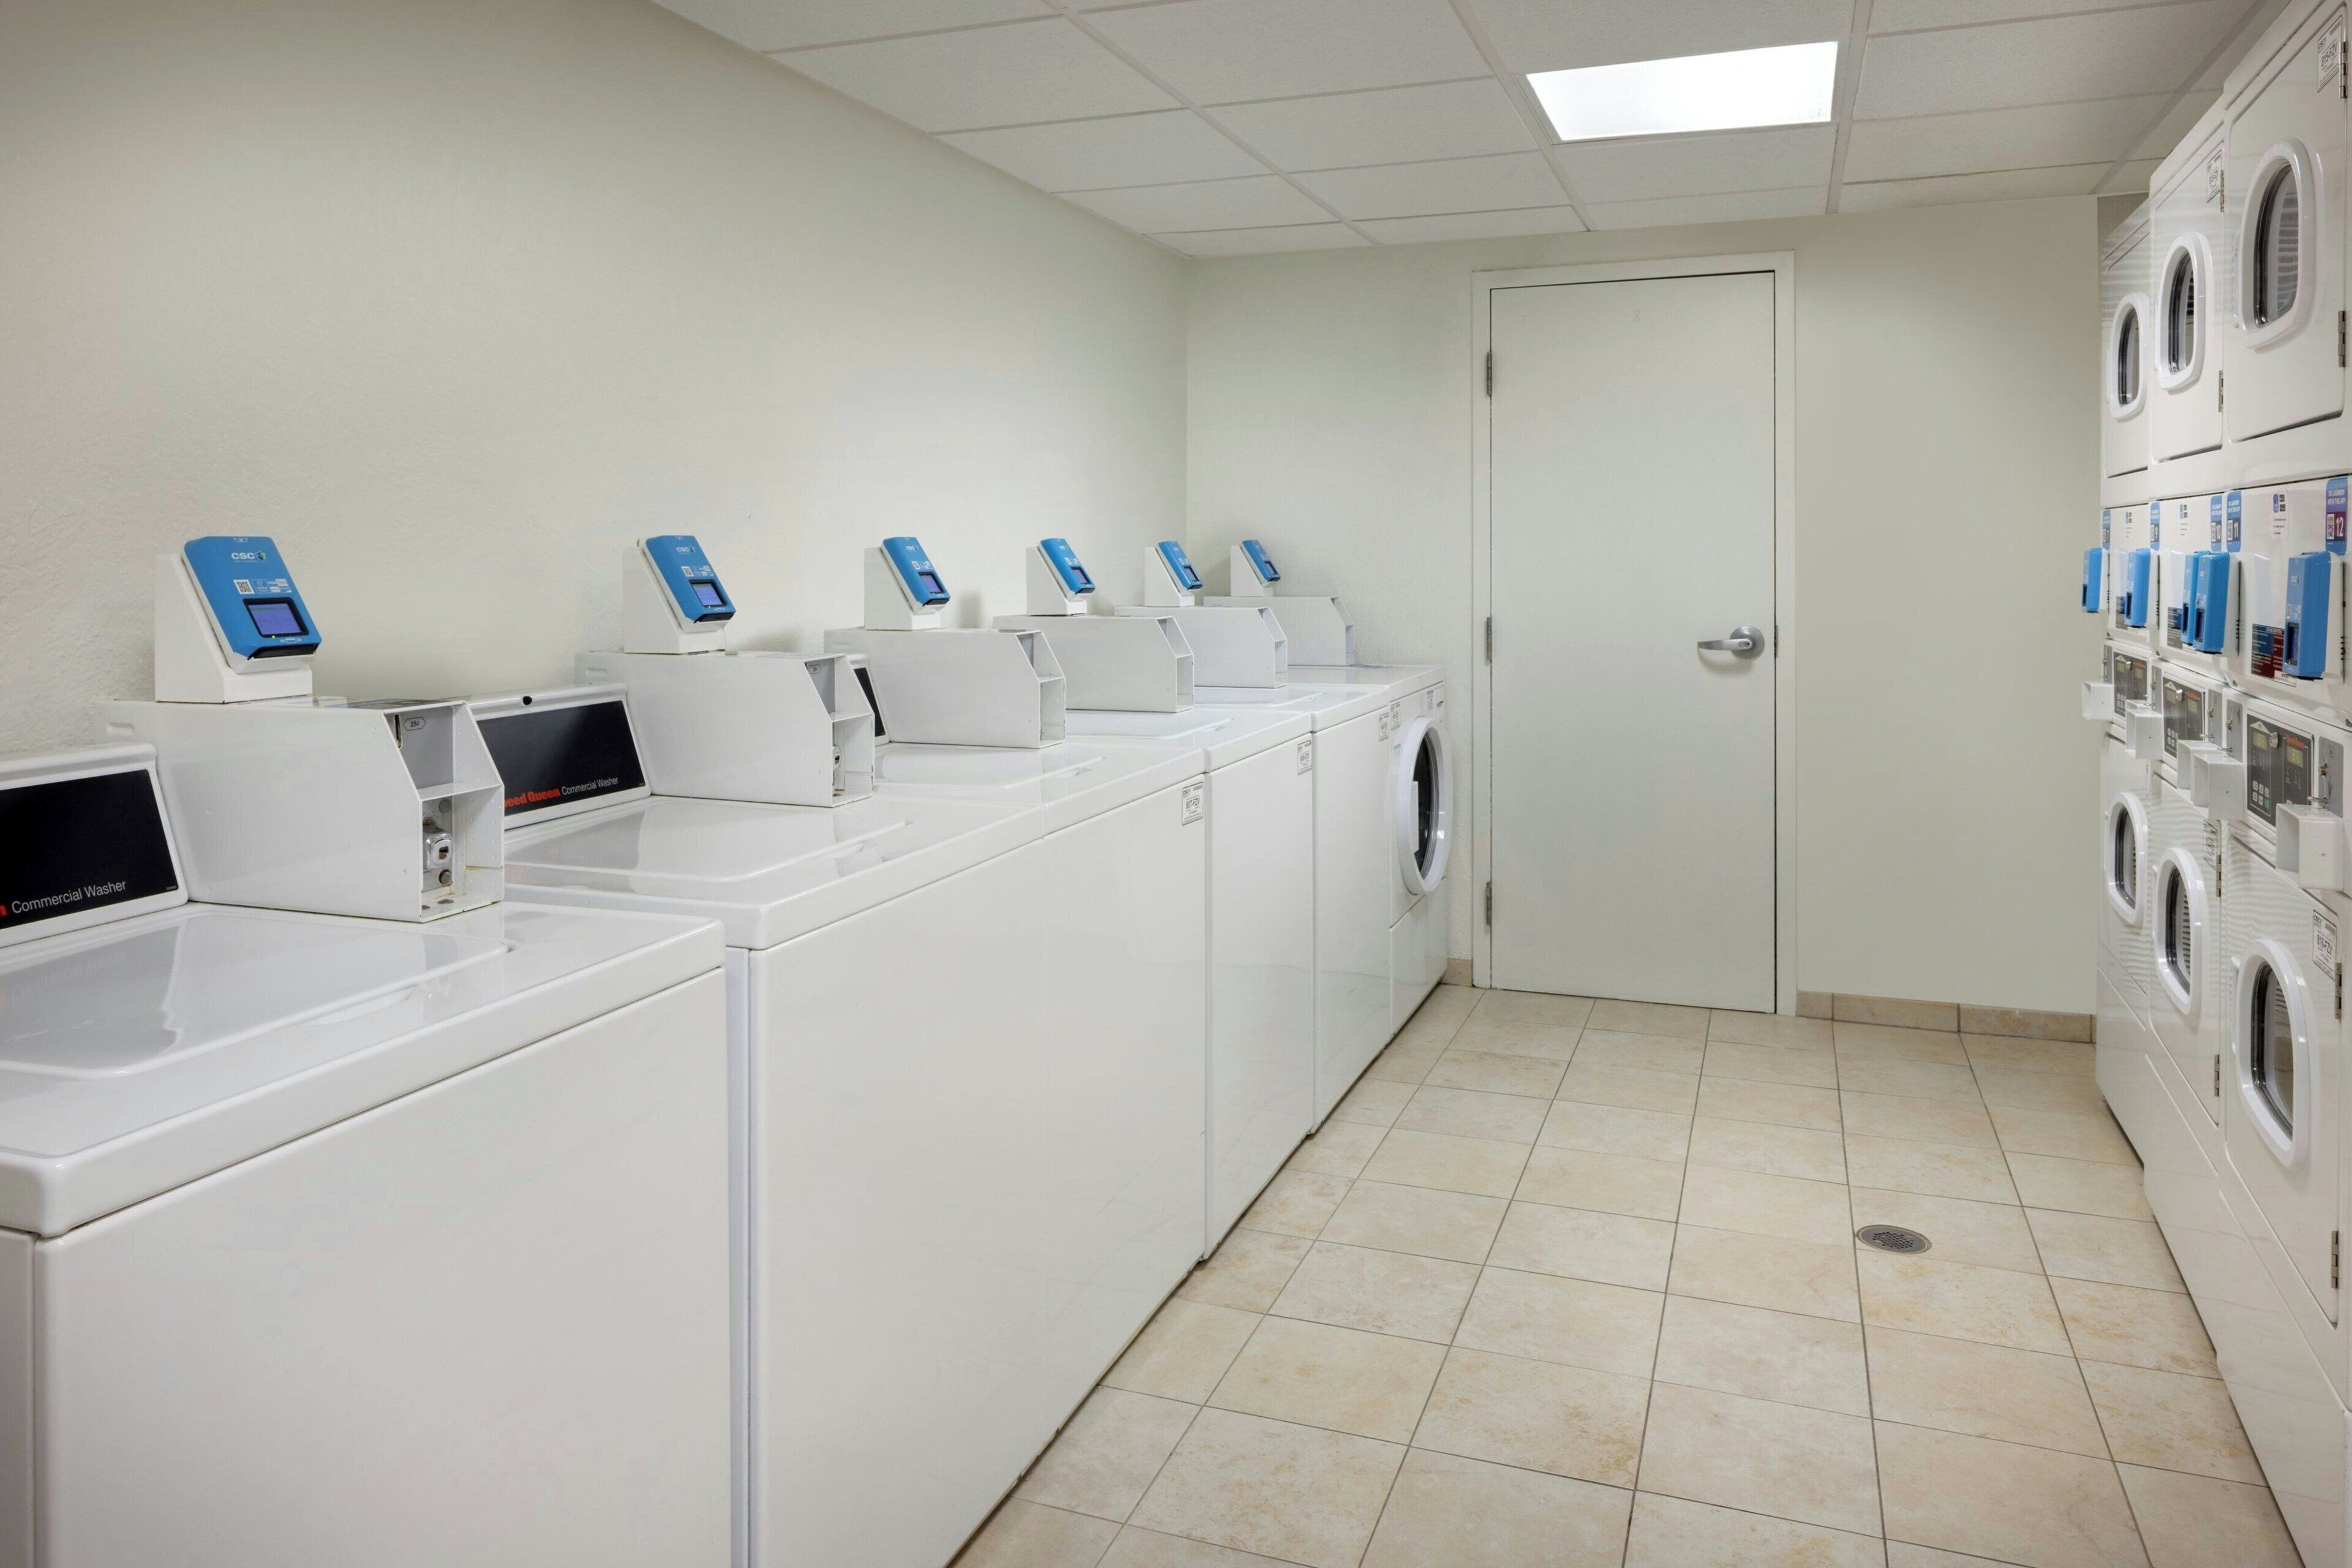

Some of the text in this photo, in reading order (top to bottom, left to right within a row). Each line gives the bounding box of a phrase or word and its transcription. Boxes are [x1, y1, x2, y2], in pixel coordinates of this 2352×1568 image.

[2336, 516, 2344, 537] 12
[504, 777, 619, 807] eed Queen Commercial Washer
[12, 888, 83, 913] Commercial
[83, 881, 126, 898] Washer
